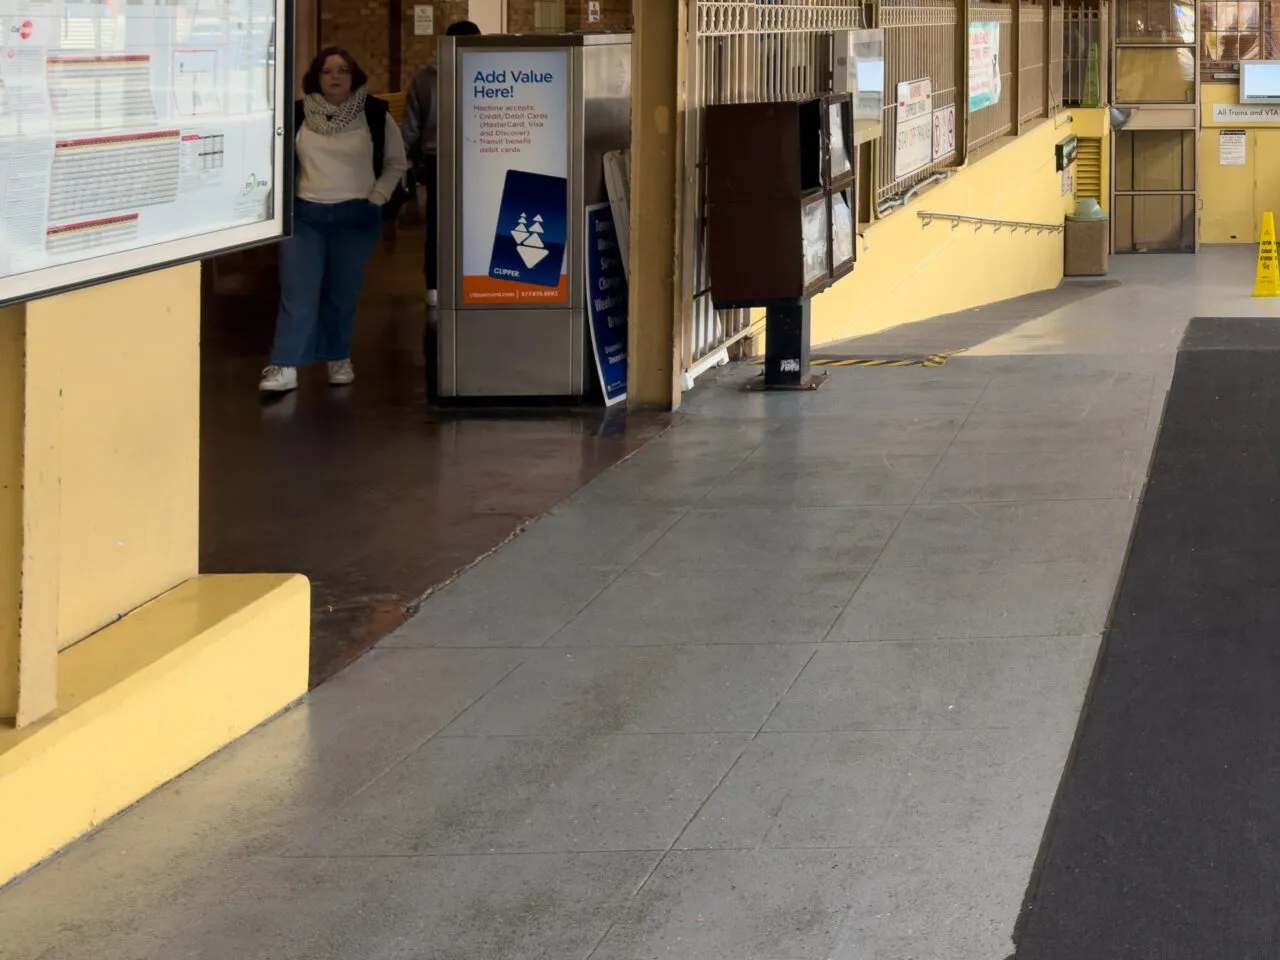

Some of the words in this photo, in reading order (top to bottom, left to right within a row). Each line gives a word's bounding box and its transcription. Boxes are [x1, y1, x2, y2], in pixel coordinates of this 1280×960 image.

[473, 70, 506, 84] Add
[510, 70, 553, 84] Value
[473, 85, 514, 99] Here!
[473, 104, 504, 112] Machine
[1217, 108, 1227, 116] All
[1229, 108, 1248, 116] Trains
[1250, 108, 1263, 116] and
[493, 267, 520, 277] CLIPPER
